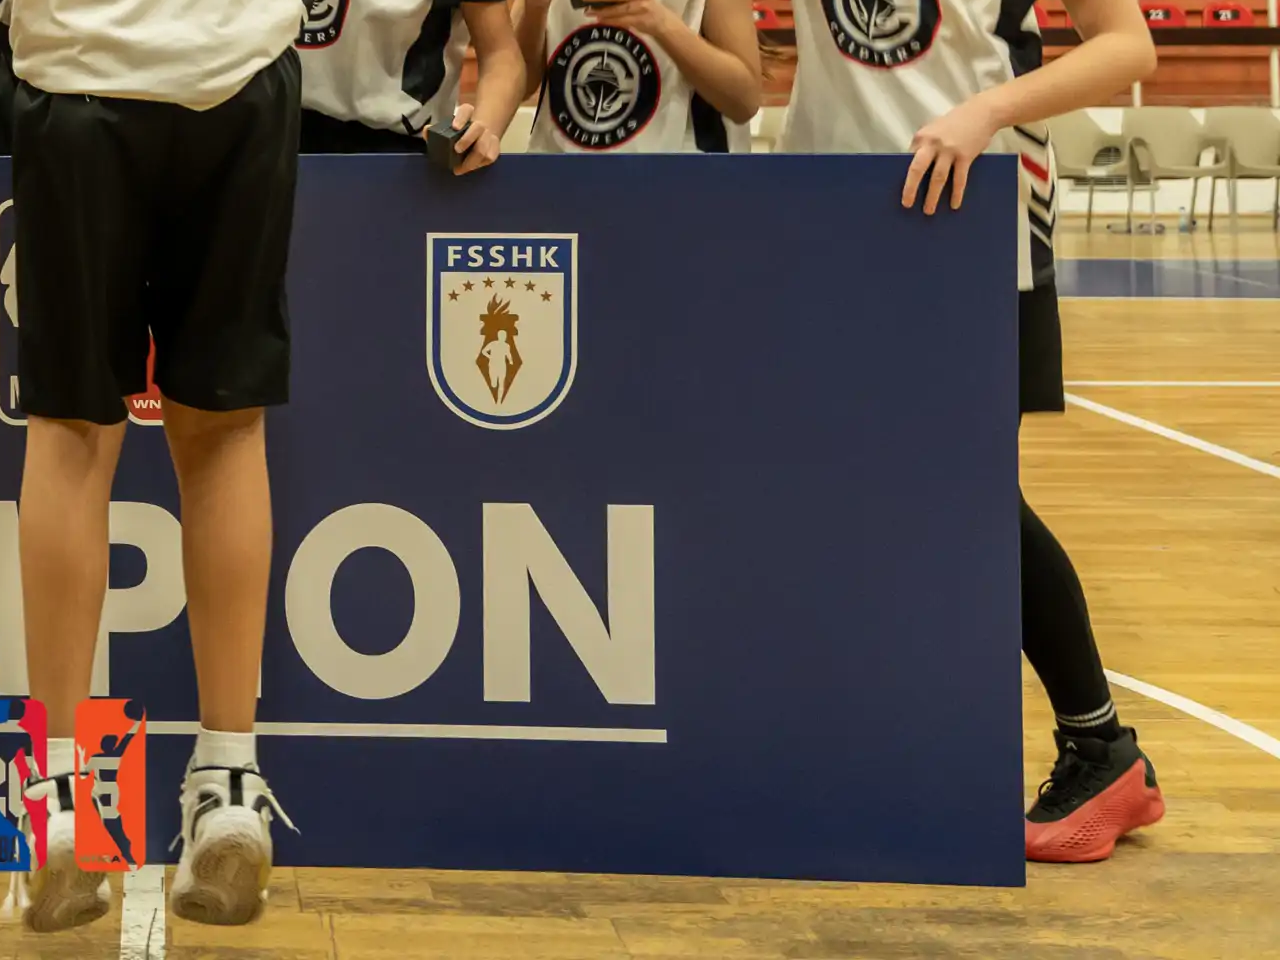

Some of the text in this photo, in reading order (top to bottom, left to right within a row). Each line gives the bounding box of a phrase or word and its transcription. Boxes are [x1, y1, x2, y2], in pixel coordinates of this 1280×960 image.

[556, 26, 653, 76] LOS ANGELES
[447, 245, 559, 268] FSSHK
